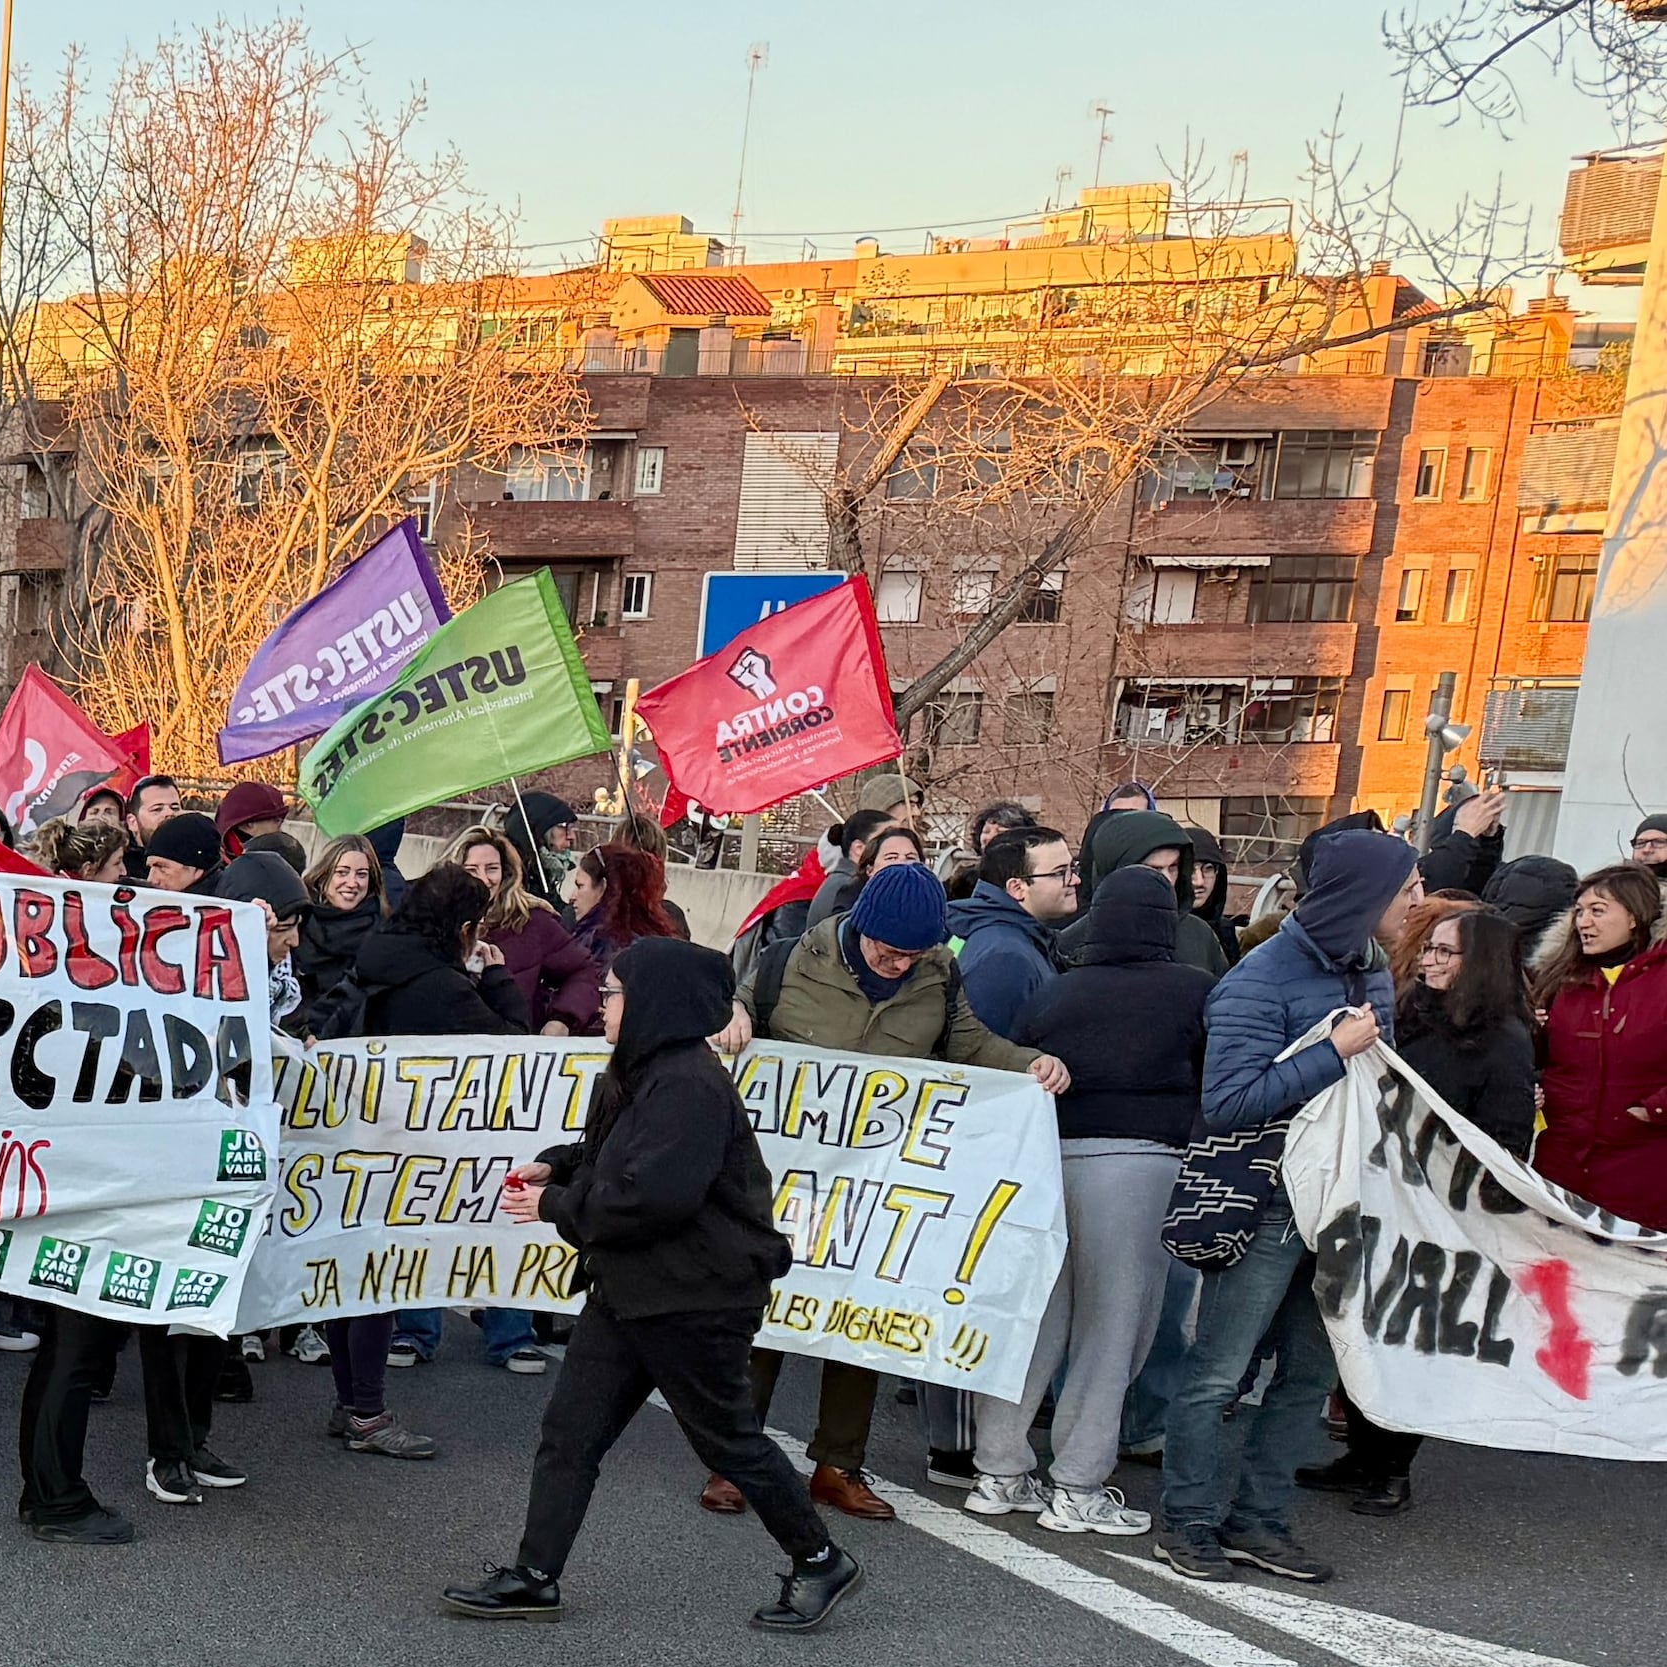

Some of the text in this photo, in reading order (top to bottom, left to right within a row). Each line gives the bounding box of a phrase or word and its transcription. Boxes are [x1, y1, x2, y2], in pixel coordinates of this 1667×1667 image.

[228, 1131, 260, 1151] JO
[225, 1164, 262, 1174] VAGA
[206, 1204, 245, 1228] JO
[198, 1233, 235, 1250] VAGA
[45, 1241, 82, 1265] JO
[114, 1255, 154, 1278] JO
[38, 1269, 74, 1287] VAGA
[179, 1270, 219, 1286] JO
[300, 1256, 342, 1309] JA
[359, 1243, 430, 1305] N'HI
[446, 1244, 498, 1299] HA
[109, 1285, 147, 1302] VAGA
[173, 1293, 207, 1304] VAGA
